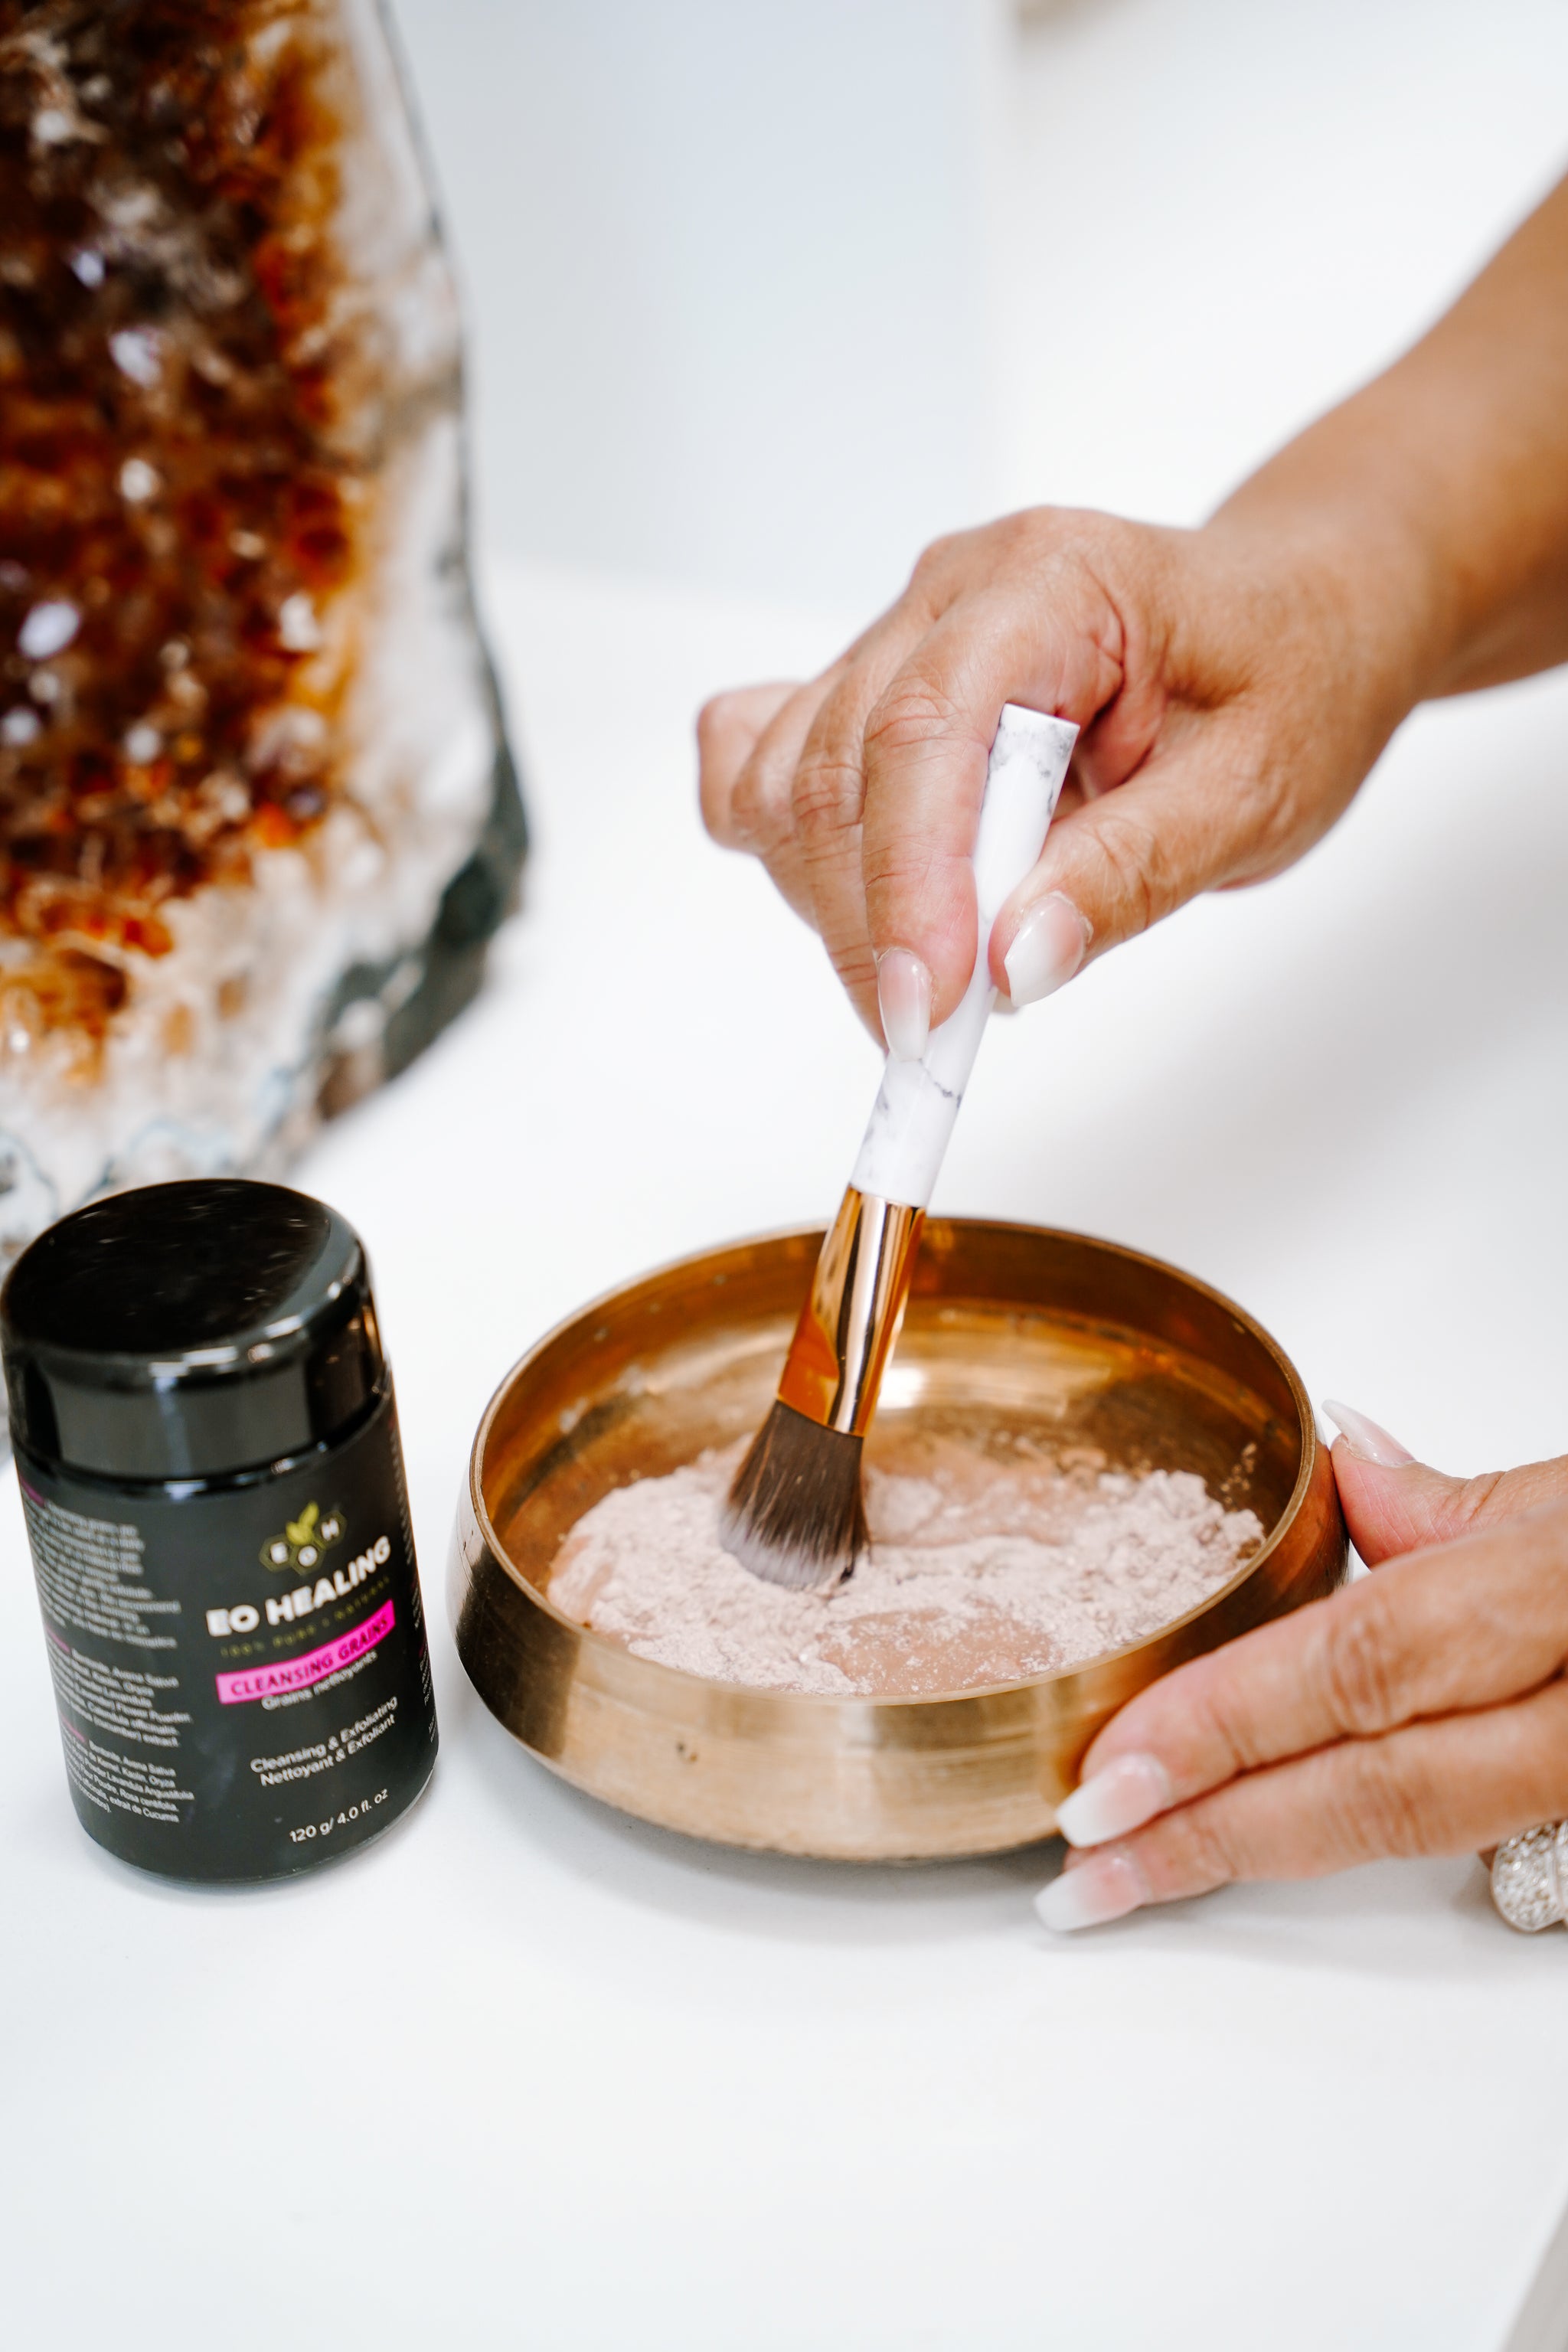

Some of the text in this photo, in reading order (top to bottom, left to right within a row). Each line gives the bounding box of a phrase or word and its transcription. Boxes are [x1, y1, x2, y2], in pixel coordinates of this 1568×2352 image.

[205, 1604, 260, 1637] EO
[265, 1535, 391, 1625] HEALING
[230, 1615, 387, 1696] CLEANSING GRAINS
[261, 1648, 377, 1710] Grains nettoyants
[250, 1743, 327, 1773] Cleansing
[328, 1735, 339, 1751] &
[340, 1696, 398, 1743] Exfoliating
[260, 1754, 335, 1786] Nettoyant
[335, 1748, 346, 1762] &
[347, 1713, 395, 1754] Exfoliant
[289, 1788, 389, 1843] 120 g/ 4.0 fl. oz
